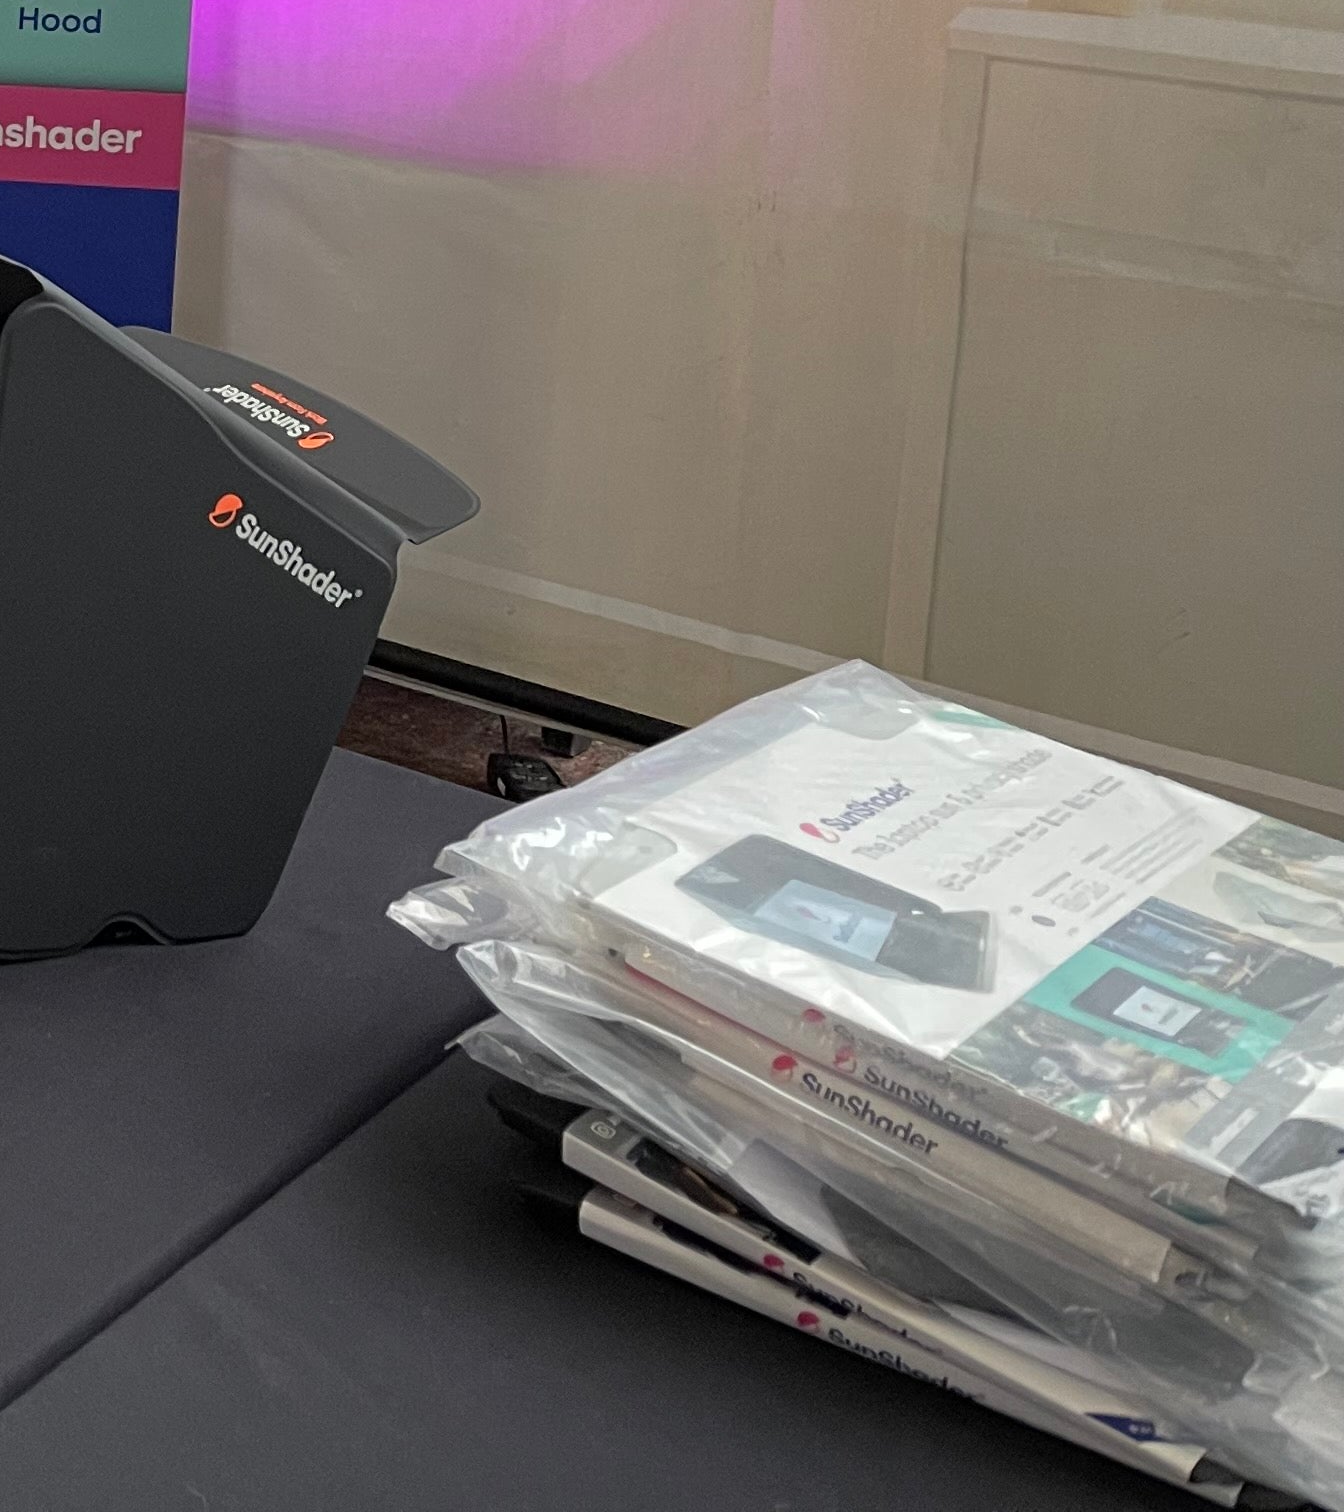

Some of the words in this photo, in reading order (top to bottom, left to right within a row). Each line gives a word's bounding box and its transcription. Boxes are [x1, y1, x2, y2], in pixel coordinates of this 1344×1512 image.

[18, 7, 102, 34] Hood
[235, 513, 354, 608] SunShader
[802, 1072, 939, 1155] SunShader
[864, 1065, 1009, 1150] SunShader
